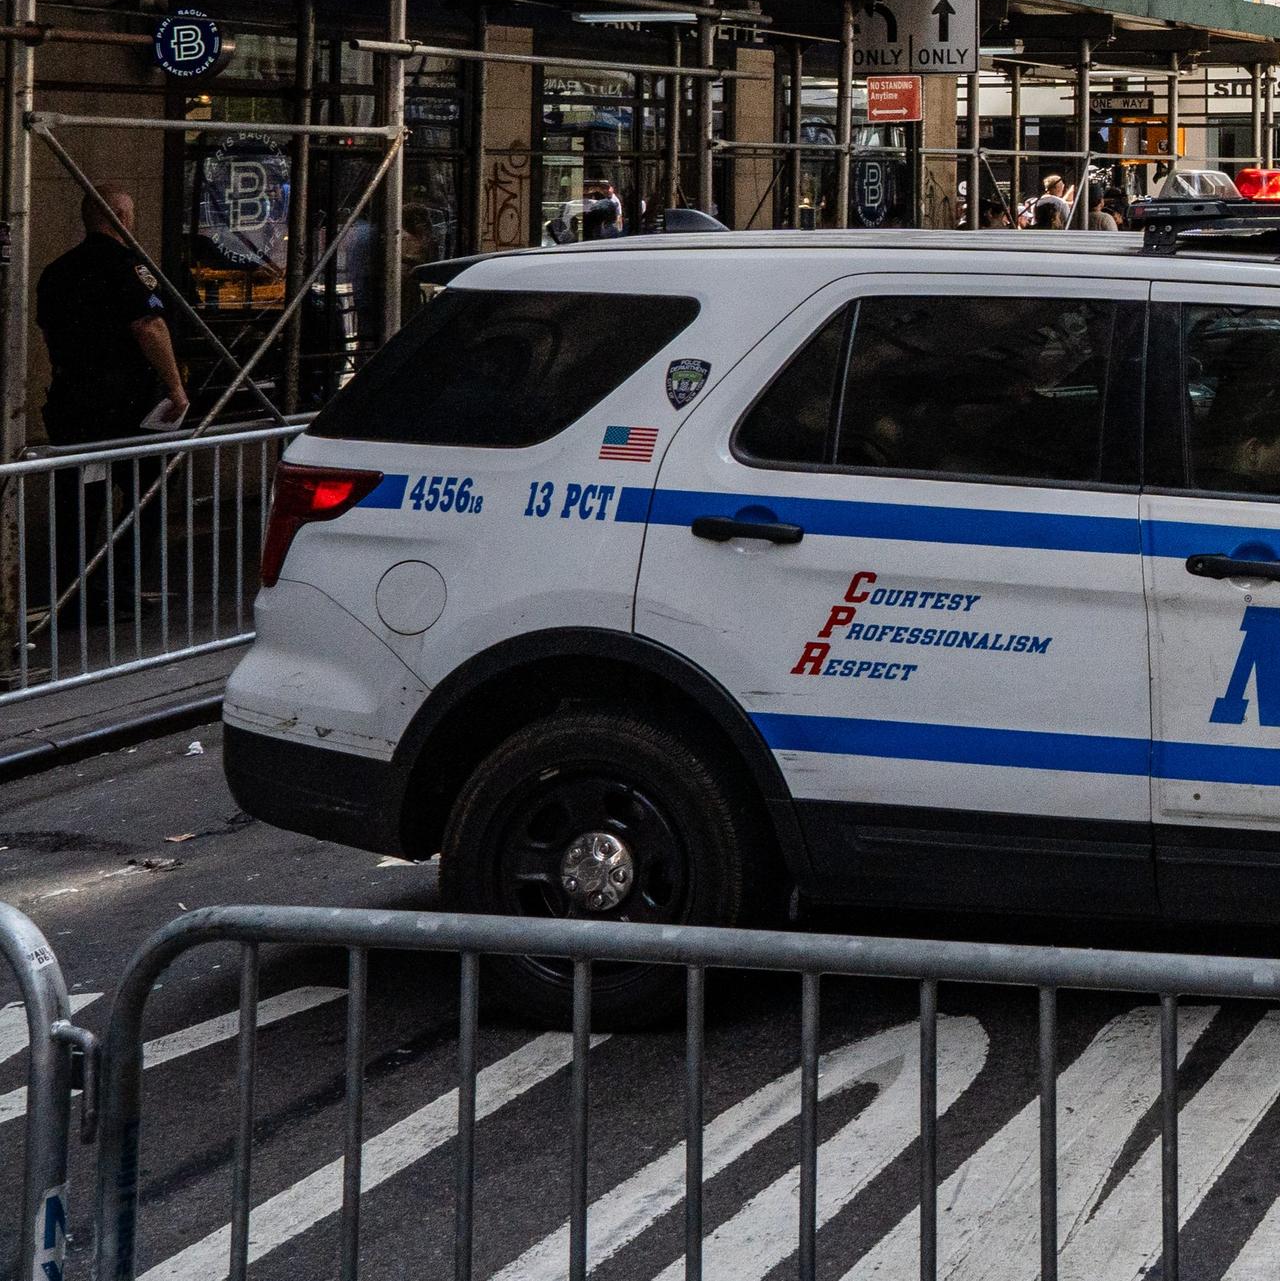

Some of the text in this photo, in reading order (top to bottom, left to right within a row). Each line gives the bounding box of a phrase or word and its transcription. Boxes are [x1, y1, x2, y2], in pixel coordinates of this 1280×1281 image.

[853, 49, 903, 65] ONLY
[918, 49, 969, 64] ONLY
[162, 61, 193, 77] BAKERY
[881, 81, 913, 89] STANDING
[871, 92, 898, 101] Anytime
[1092, 98, 1144, 108] ONE WAY
[524, 481, 616, 520] 13 PCT
[844, 571, 981, 612] COURTESY
[817, 605, 1053, 655] PROFESSIONALISM
[790, 642, 918, 681] RESPECT
